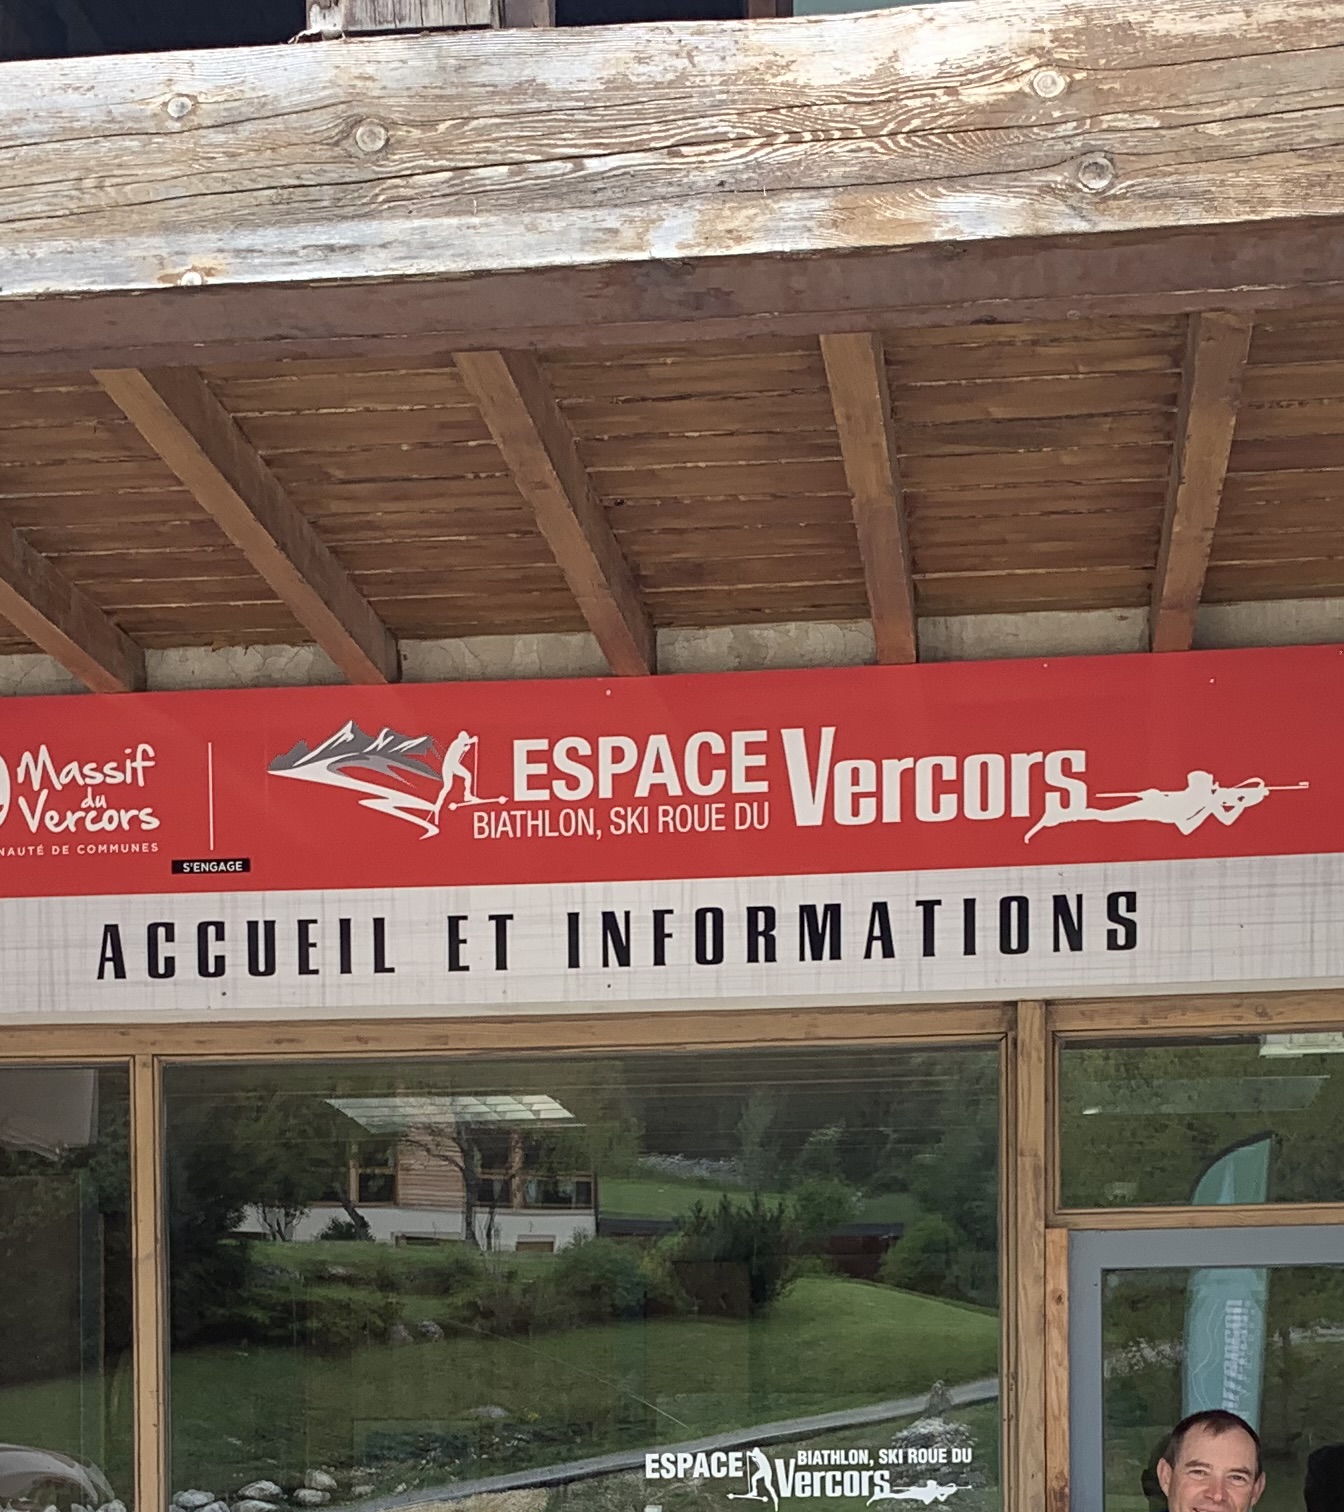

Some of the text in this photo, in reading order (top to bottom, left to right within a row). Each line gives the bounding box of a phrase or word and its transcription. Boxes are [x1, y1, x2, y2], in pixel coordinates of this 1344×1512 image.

[16, 744, 155, 791] Massif
[512, 727, 1087, 826] ESPACE Vercors
[18, 789, 160, 833] Vercors
[80, 787, 107, 809] du
[473, 803, 769, 839] BIATHLON, SKI ROUE DU
[52, 845, 70, 855] DE
[77, 843, 159, 854] COMMUNES
[182, 861, 243, 872] S'ENGAGE
[96, 892, 1138, 980] ACCUEIL ET INFORMATIONS
[645, 1452, 890, 1498] ESPACE Vercors
[797, 1448, 972, 1467] BIATHLON, SKI ROUE DU
